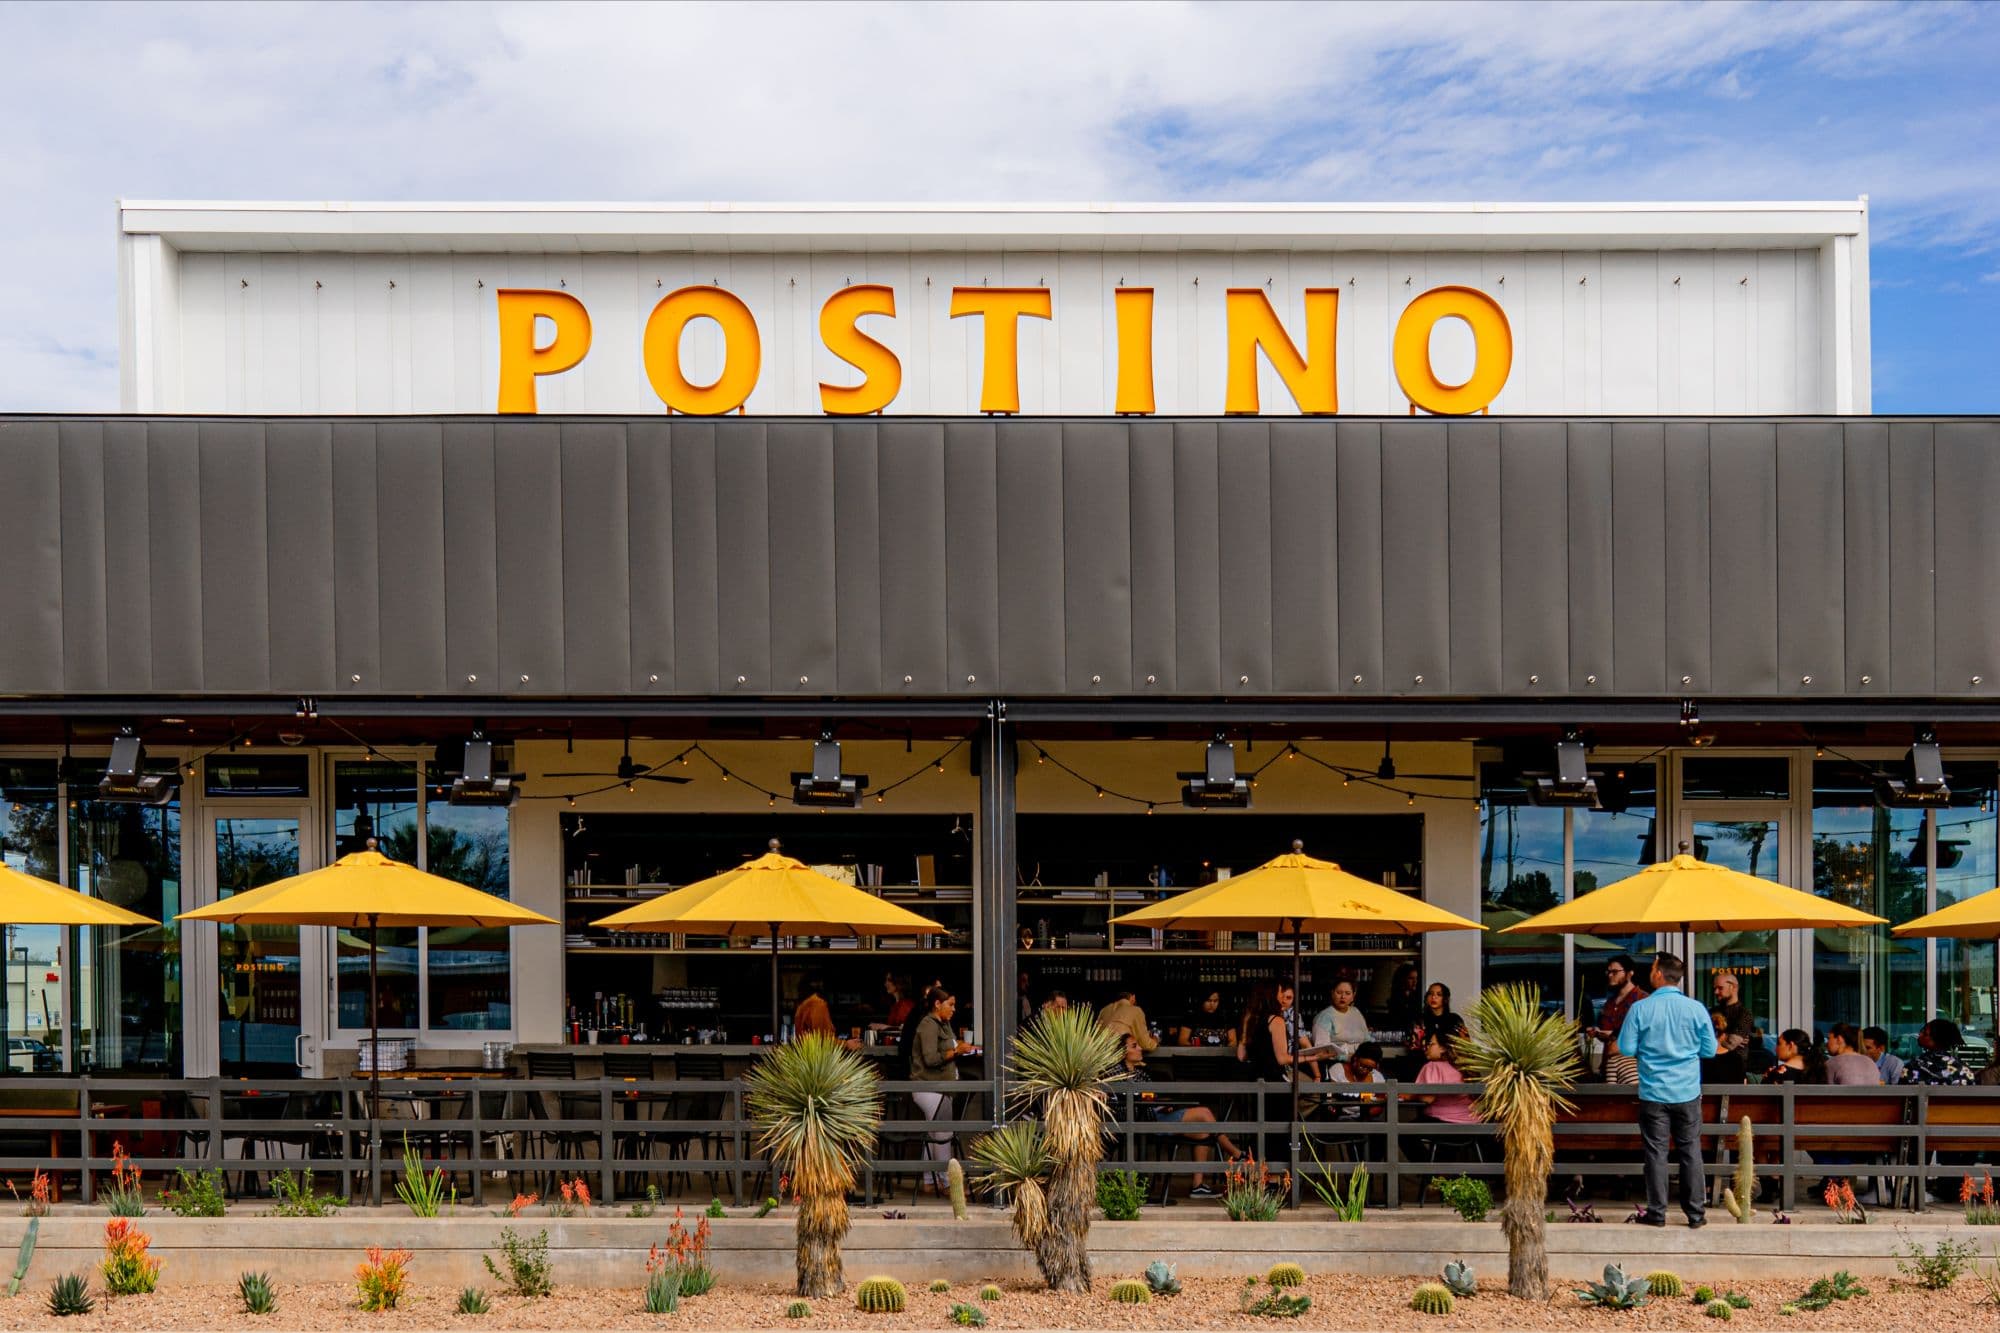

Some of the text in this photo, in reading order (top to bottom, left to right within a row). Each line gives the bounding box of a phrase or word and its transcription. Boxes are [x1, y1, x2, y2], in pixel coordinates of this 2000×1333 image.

[497, 285, 1513, 416] POSTINO
[236, 963, 284, 972] POSTINO
[1711, 967, 1760, 976] POSTINO
